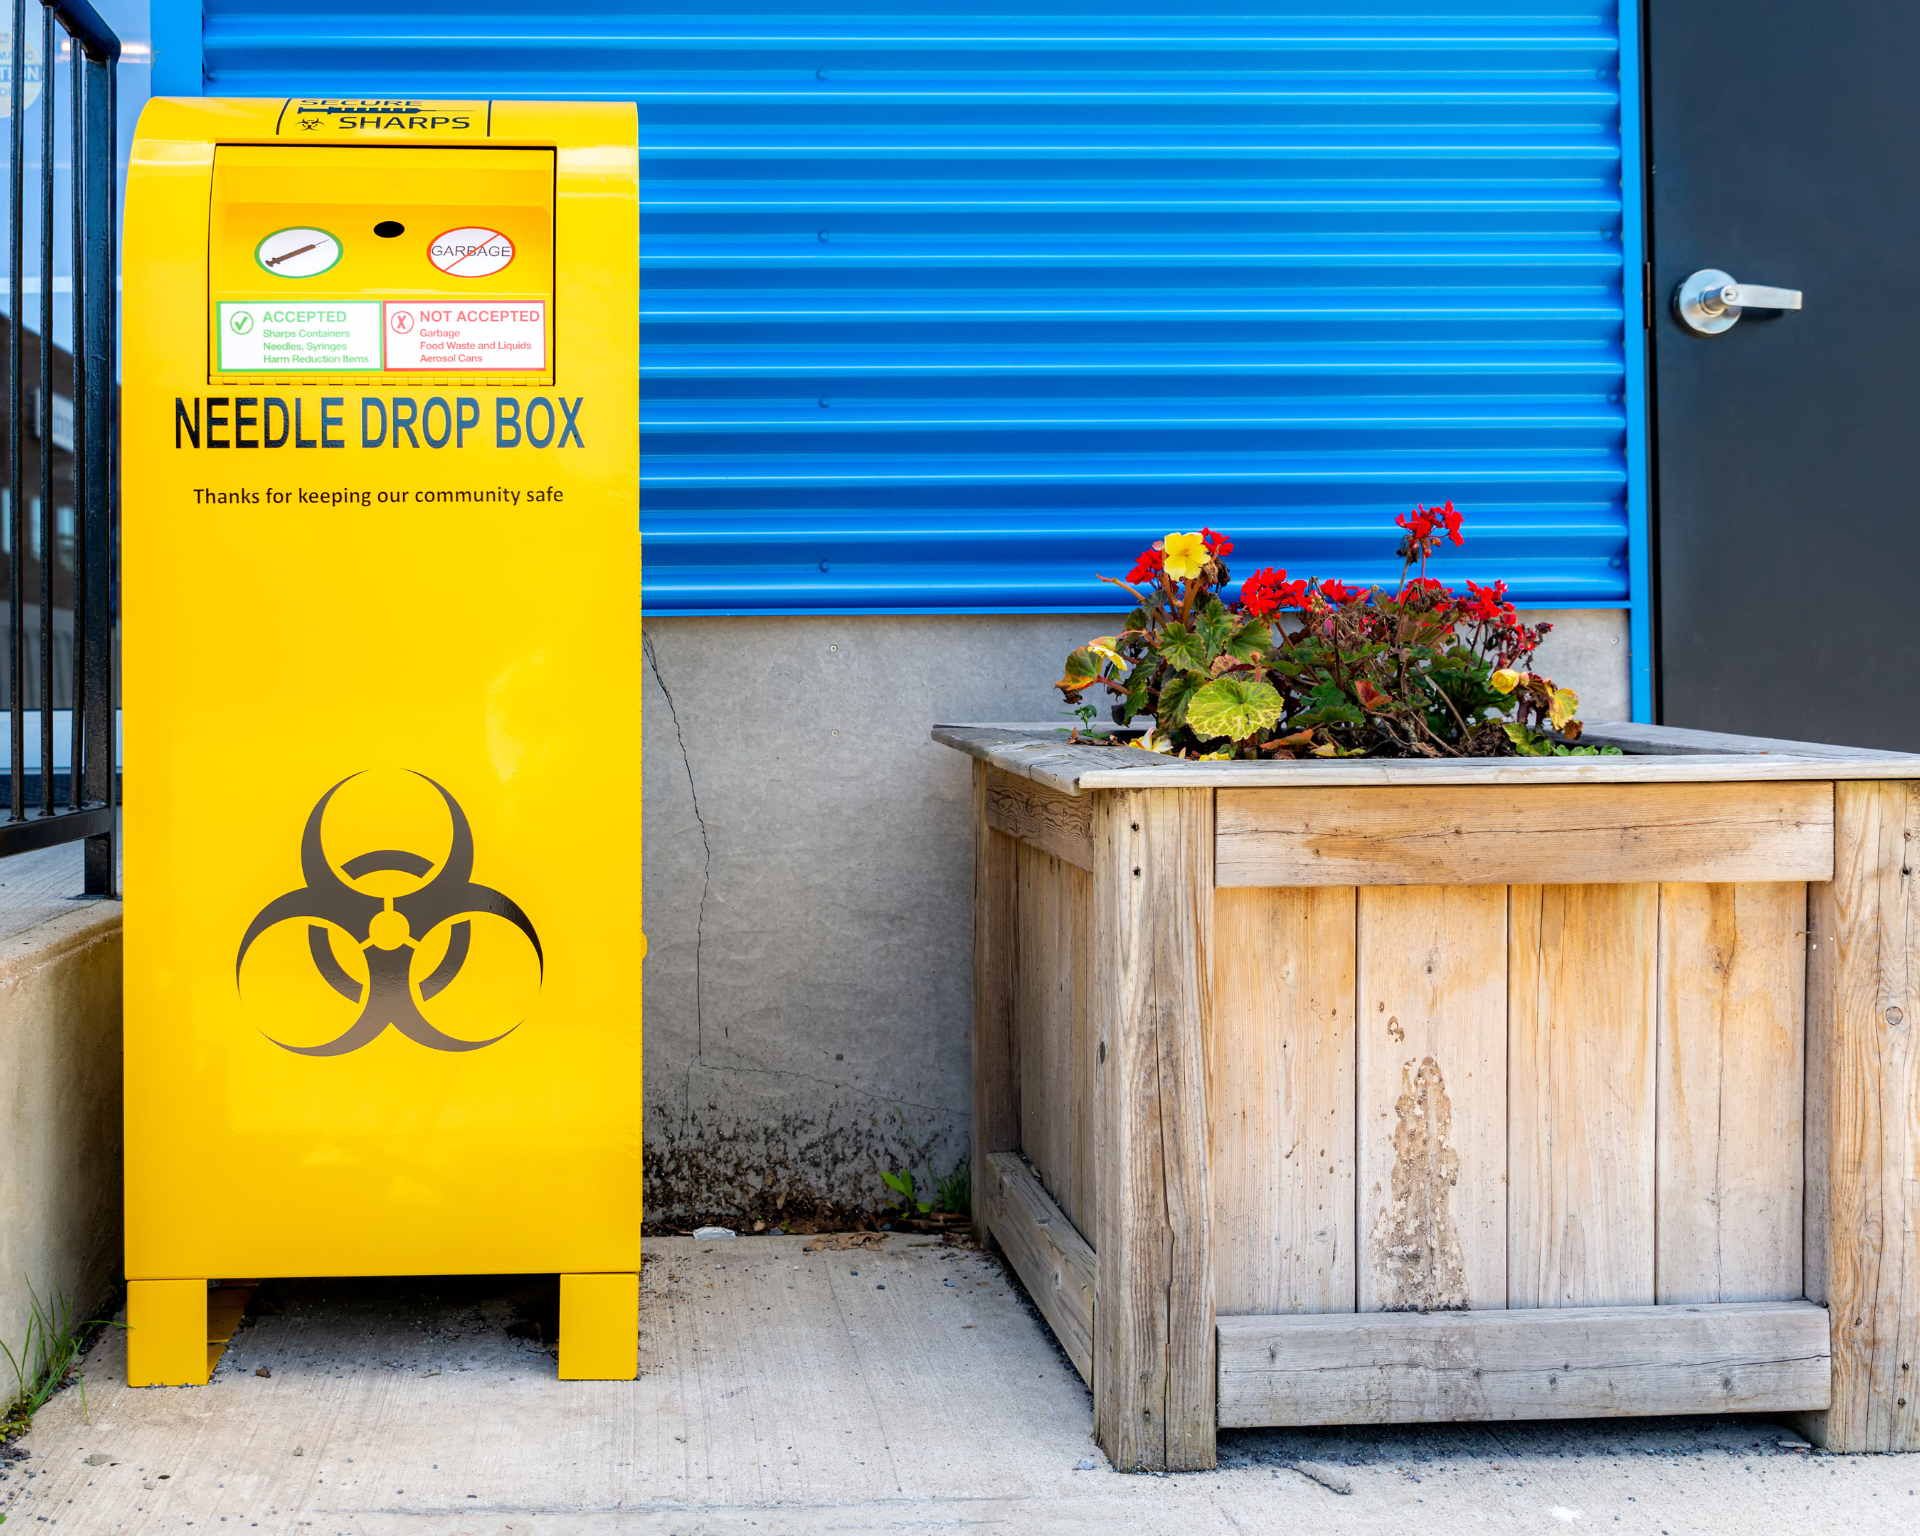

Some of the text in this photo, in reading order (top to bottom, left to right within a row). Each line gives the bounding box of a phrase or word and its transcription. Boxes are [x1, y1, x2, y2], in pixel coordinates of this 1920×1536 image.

[338, 116, 470, 130] SHARPS
[431, 245, 511, 257] GARBAGE
[262, 311, 347, 323] ACCEPTED
[420, 310, 540, 322] NOT ACCEPTED
[263, 329, 350, 339] Sharps Containers
[420, 328, 460, 339] Garbage
[263, 342, 347, 352] Needles, Syringes
[420, 341, 532, 351] Food Waste and Liquids
[263, 354, 369, 363] Harm Reduction Items
[420, 354, 483, 362] Aerosol Cans
[175, 396, 586, 449] NEEDLE DROP BOX
[193, 486, 564, 507] Thanks for keeping our community safe
